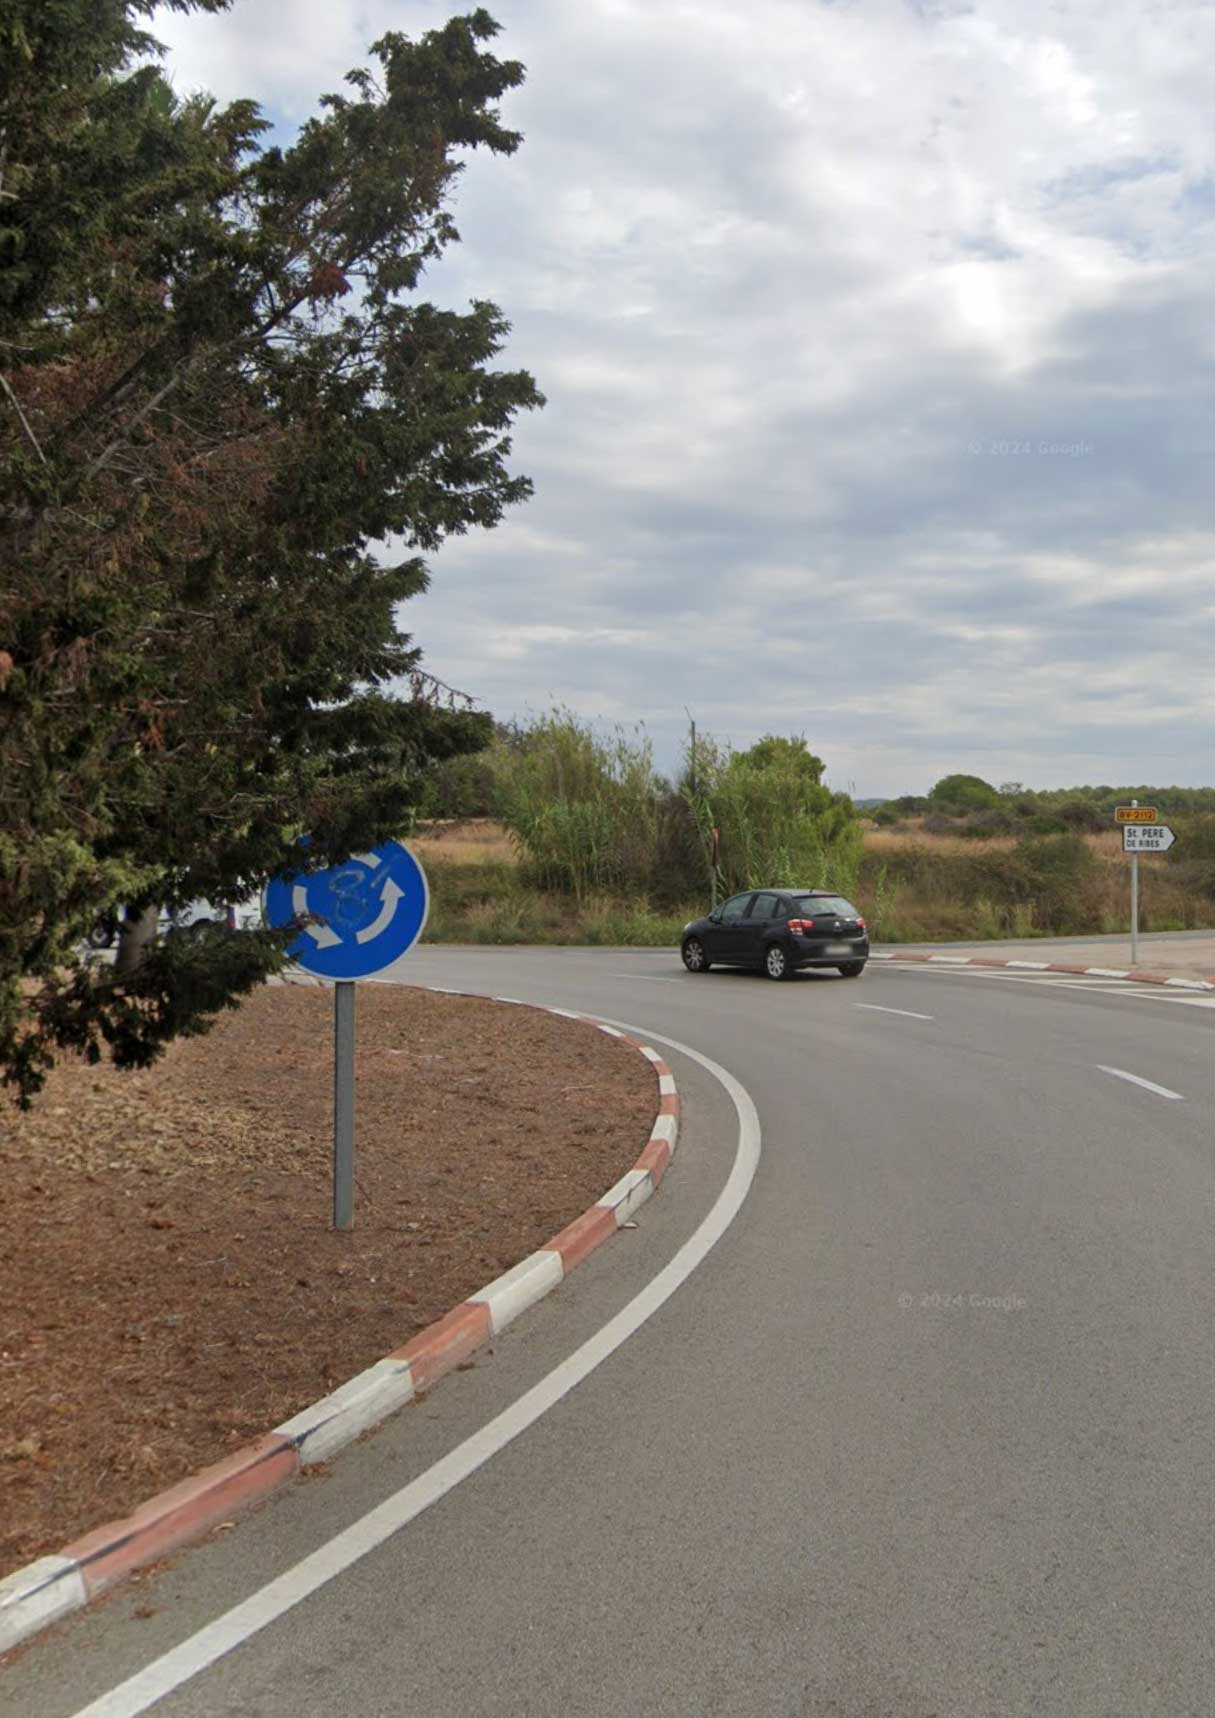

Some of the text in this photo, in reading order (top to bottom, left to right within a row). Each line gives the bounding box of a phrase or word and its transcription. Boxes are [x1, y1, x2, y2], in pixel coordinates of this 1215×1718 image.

[1142, 828, 1165, 838] PERE
[1126, 840, 1160, 848] DE RIBES
